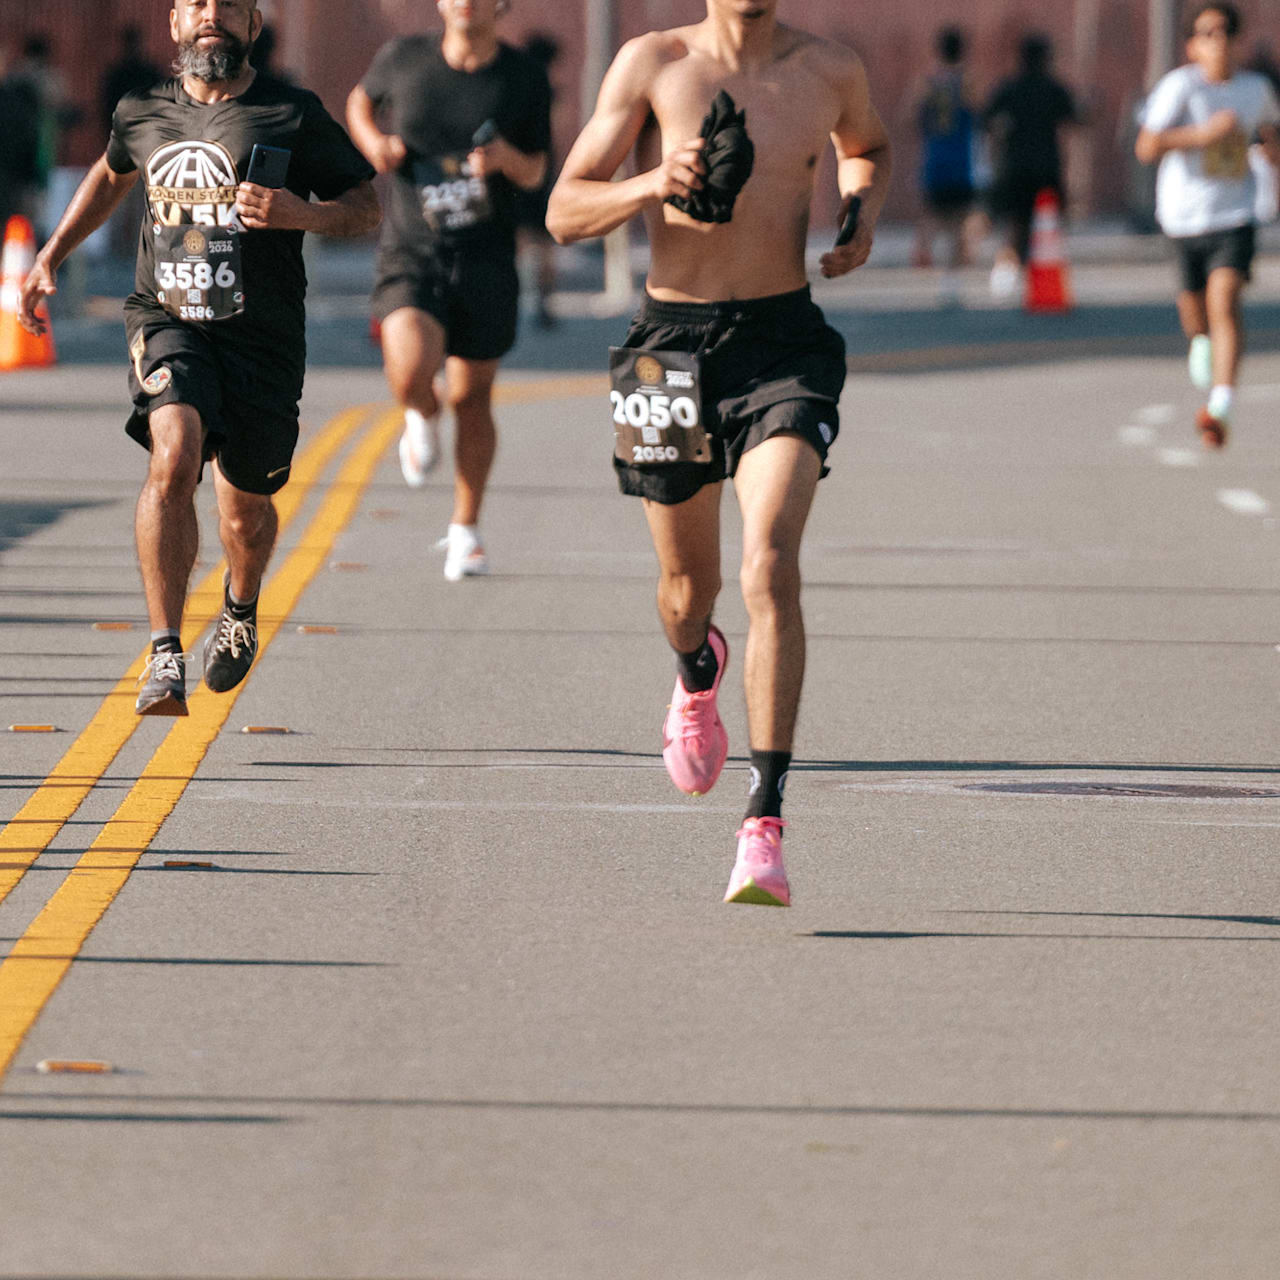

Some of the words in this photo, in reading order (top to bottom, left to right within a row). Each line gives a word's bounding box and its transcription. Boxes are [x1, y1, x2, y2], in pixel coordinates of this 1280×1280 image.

[209, 244, 233, 253] 2026
[159, 261, 236, 290] 3586
[179, 305, 215, 320] 3586
[609, 390, 699, 430] 2050
[632, 445, 679, 463] 2050
